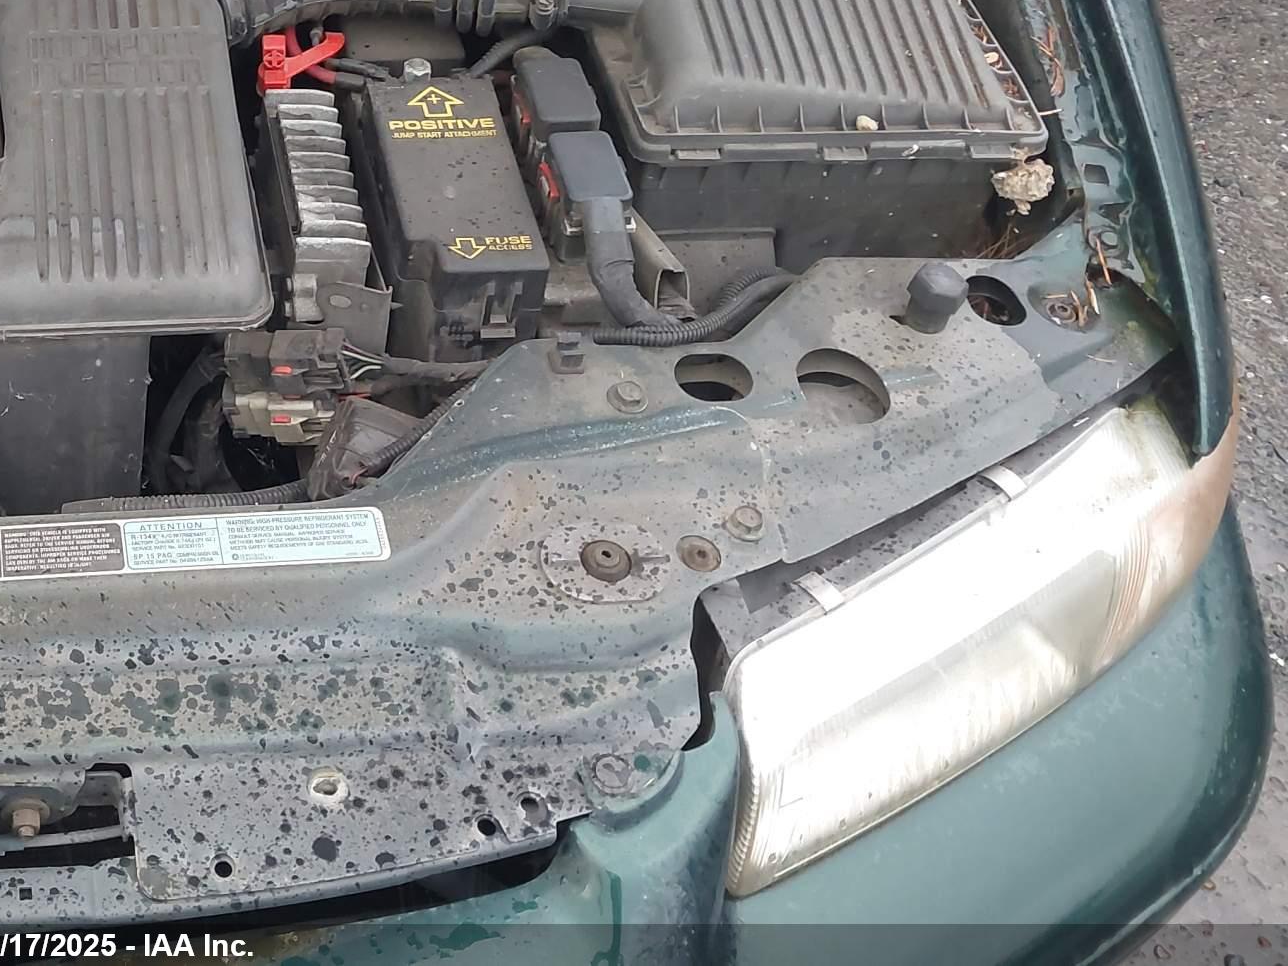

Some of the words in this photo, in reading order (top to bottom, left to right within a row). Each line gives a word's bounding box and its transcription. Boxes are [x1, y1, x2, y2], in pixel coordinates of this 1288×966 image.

[389, 118, 496, 131] POSITIVE
[444, 130, 497, 138] ATTACHMENT
[485, 235, 532, 245] FUSE
[140, 522, 202, 531] ATTENTION
